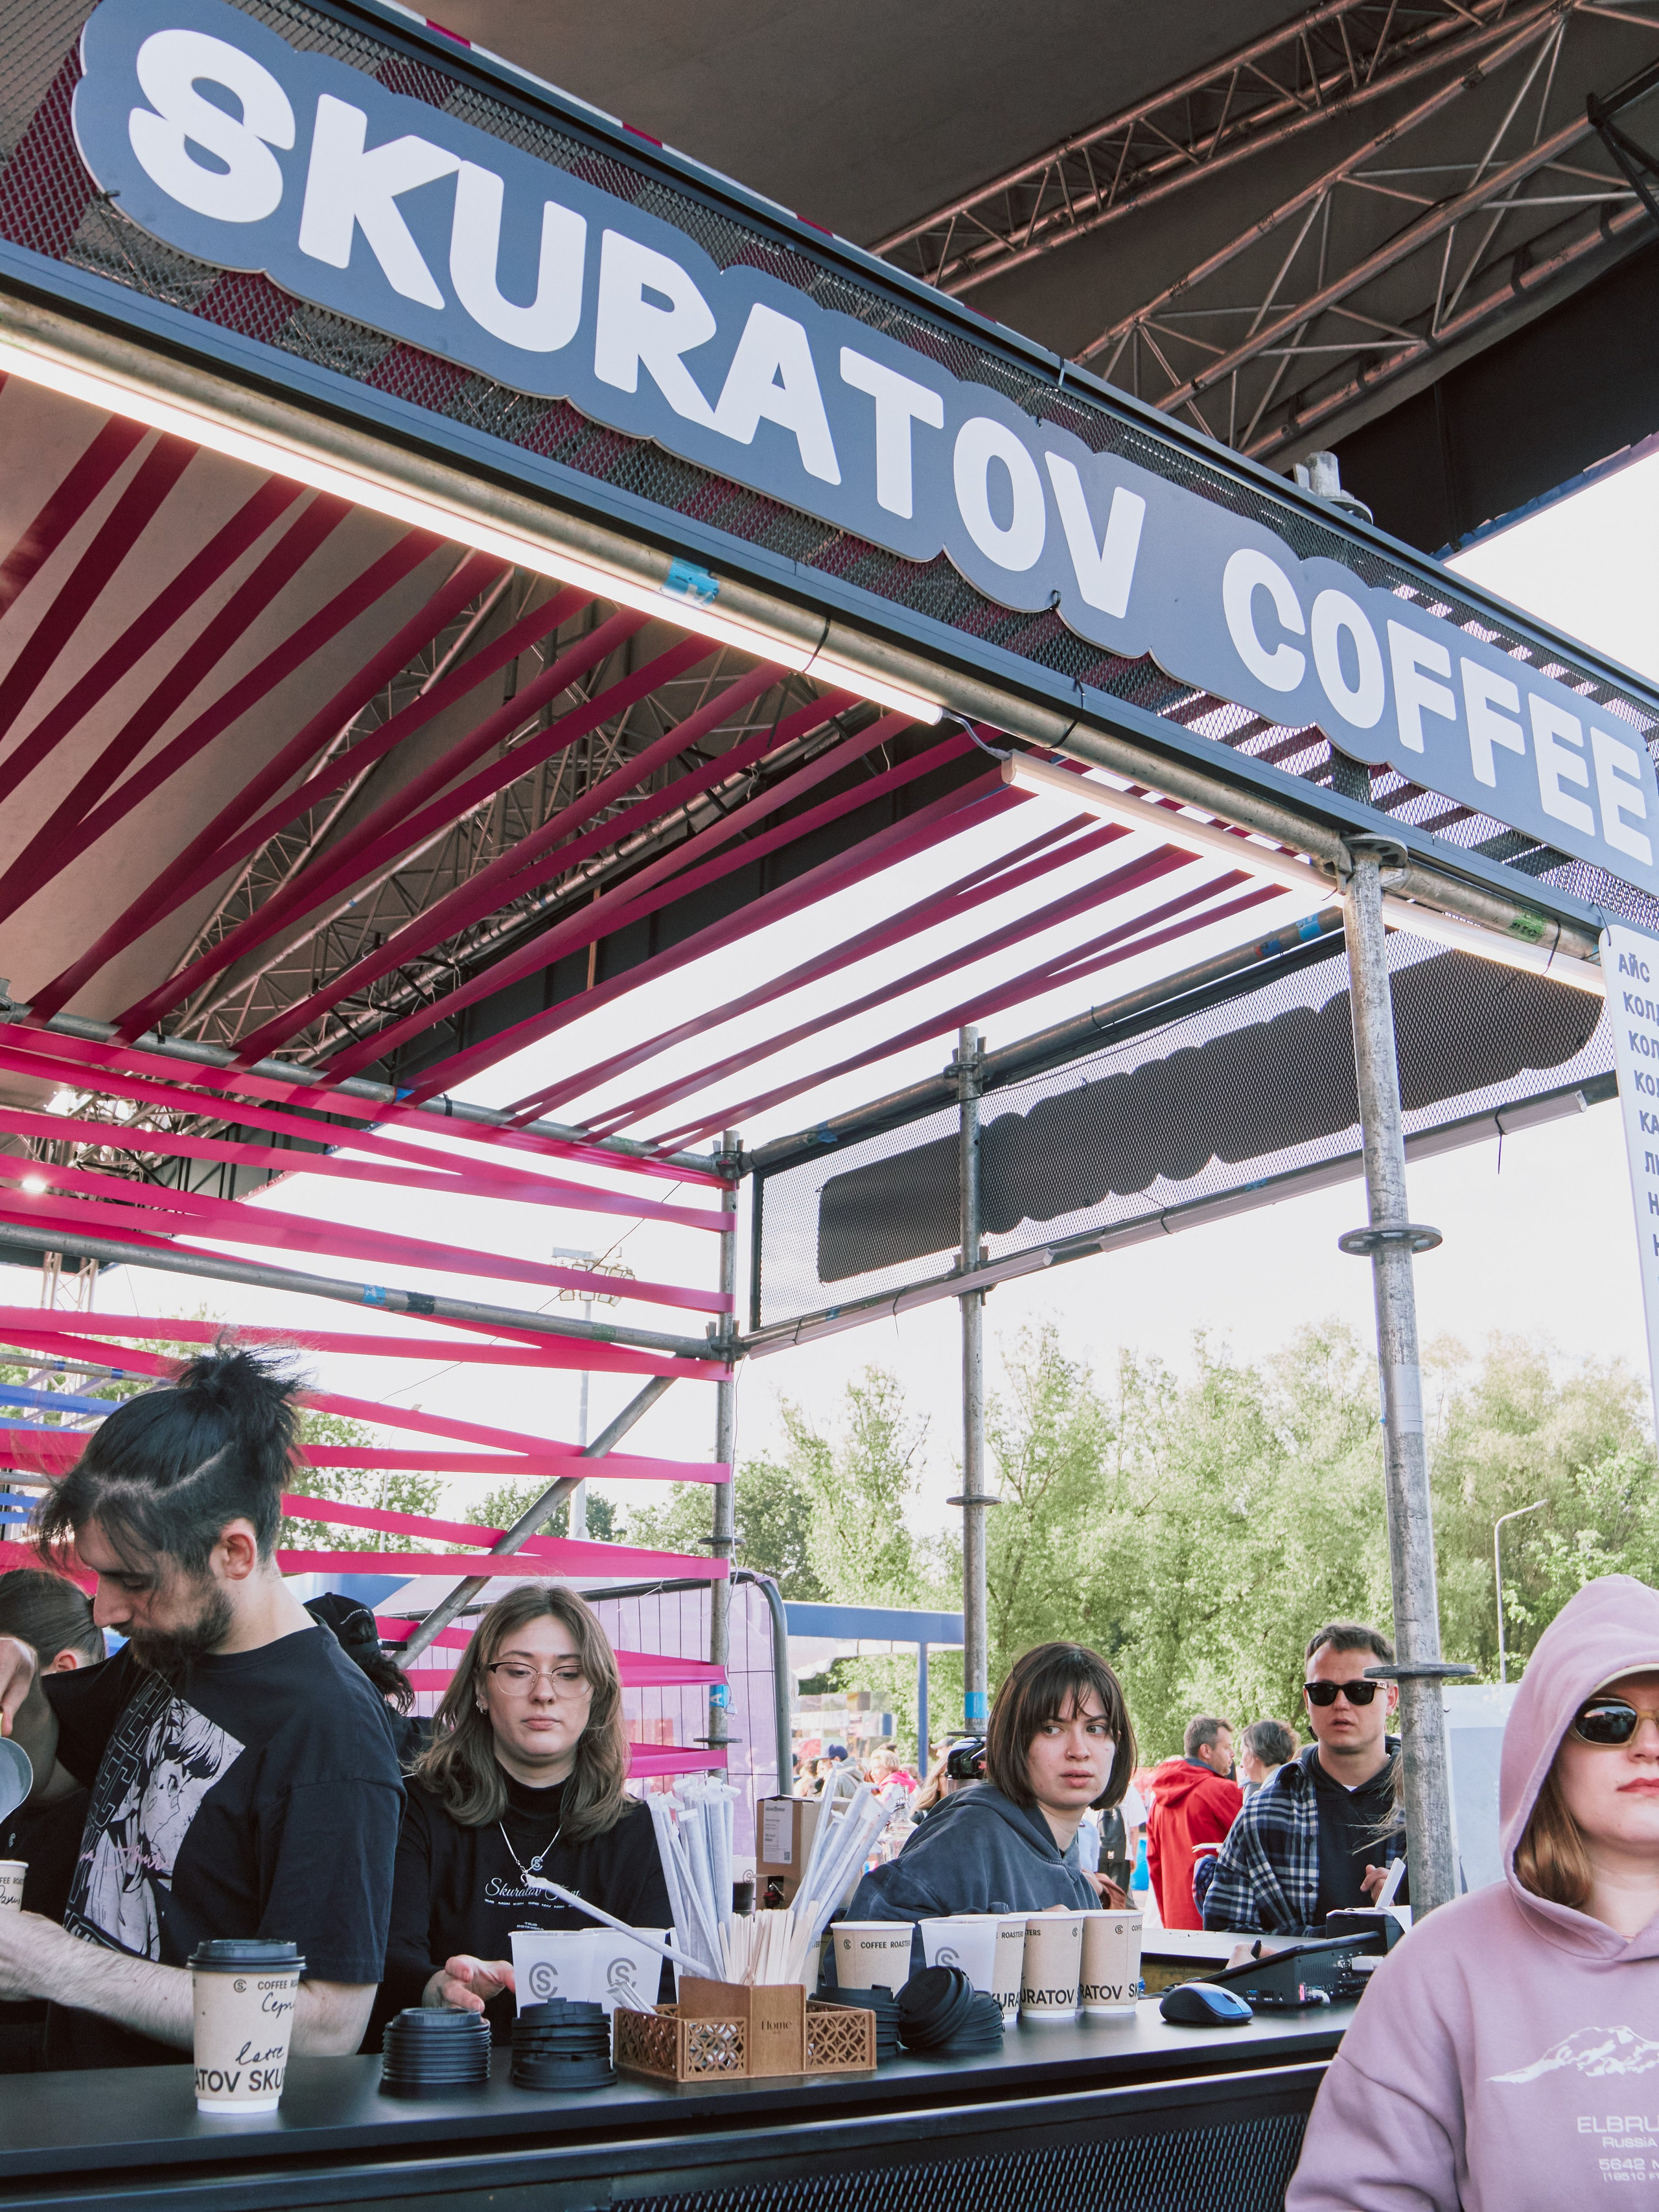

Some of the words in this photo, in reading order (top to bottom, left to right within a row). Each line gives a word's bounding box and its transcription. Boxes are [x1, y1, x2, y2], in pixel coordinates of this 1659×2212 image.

[128, 29, 1146, 619] SKURATOV
[1222, 548, 1653, 867] COFFEE
[1619, 952, 1650, 983] АЙС
[1623, 991, 1659, 1027] КОЛ
[257, 1980, 288, 1990] COFFEE
[761, 2020, 792, 2031] Home
[1598, 2158, 1646, 2171] 5642
